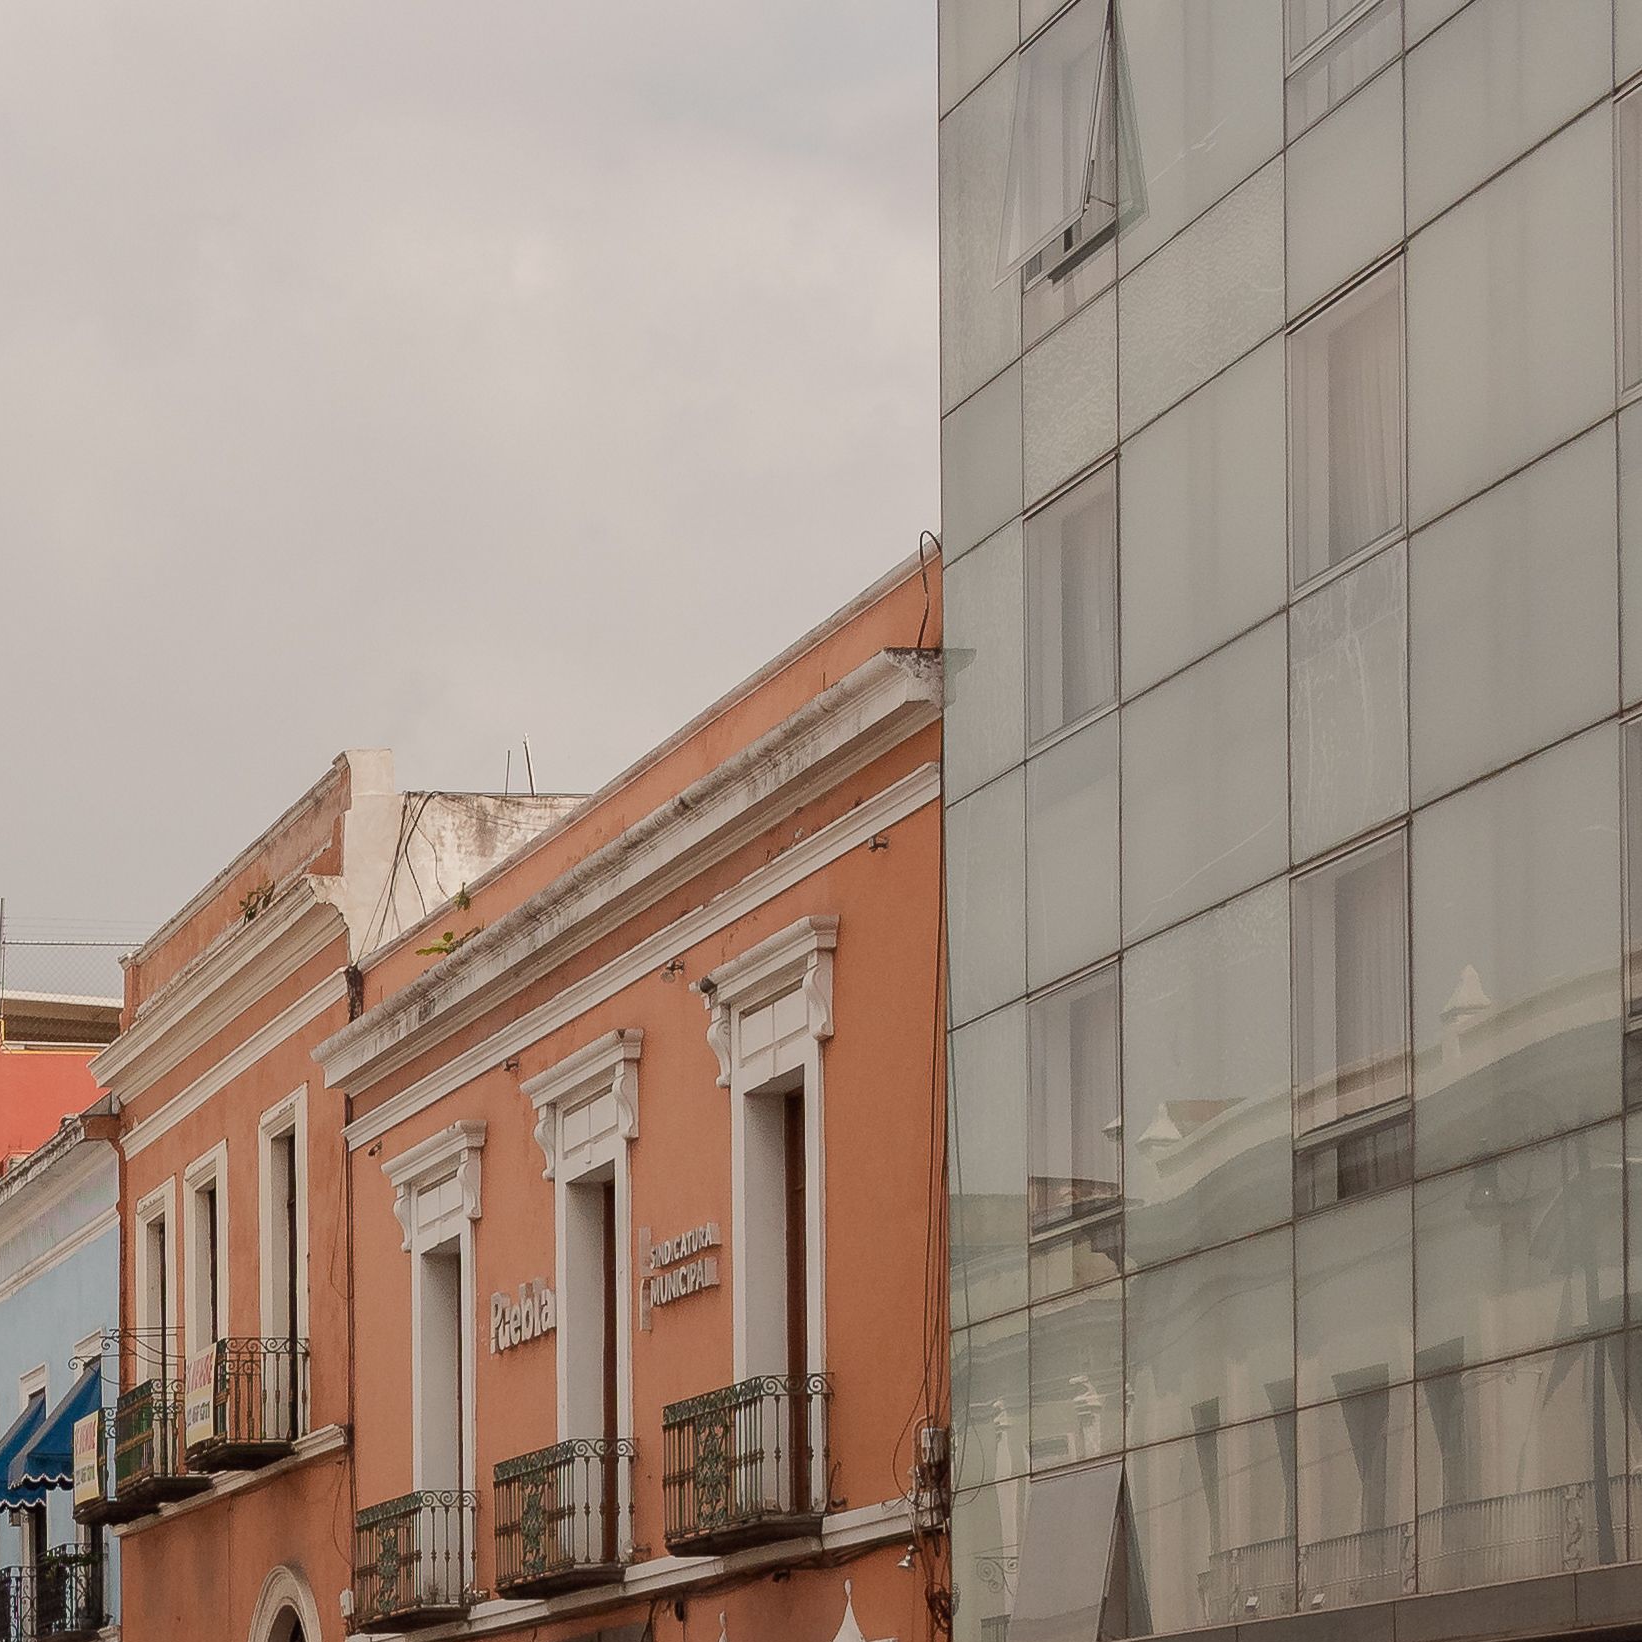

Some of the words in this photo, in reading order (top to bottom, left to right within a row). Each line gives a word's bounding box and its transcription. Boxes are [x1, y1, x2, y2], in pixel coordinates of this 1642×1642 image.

[650, 1223, 720, 1269] SINDICATURA
[650, 1258, 718, 1307] MUNICIPAL
[491, 1281, 556, 1356] Puebla
